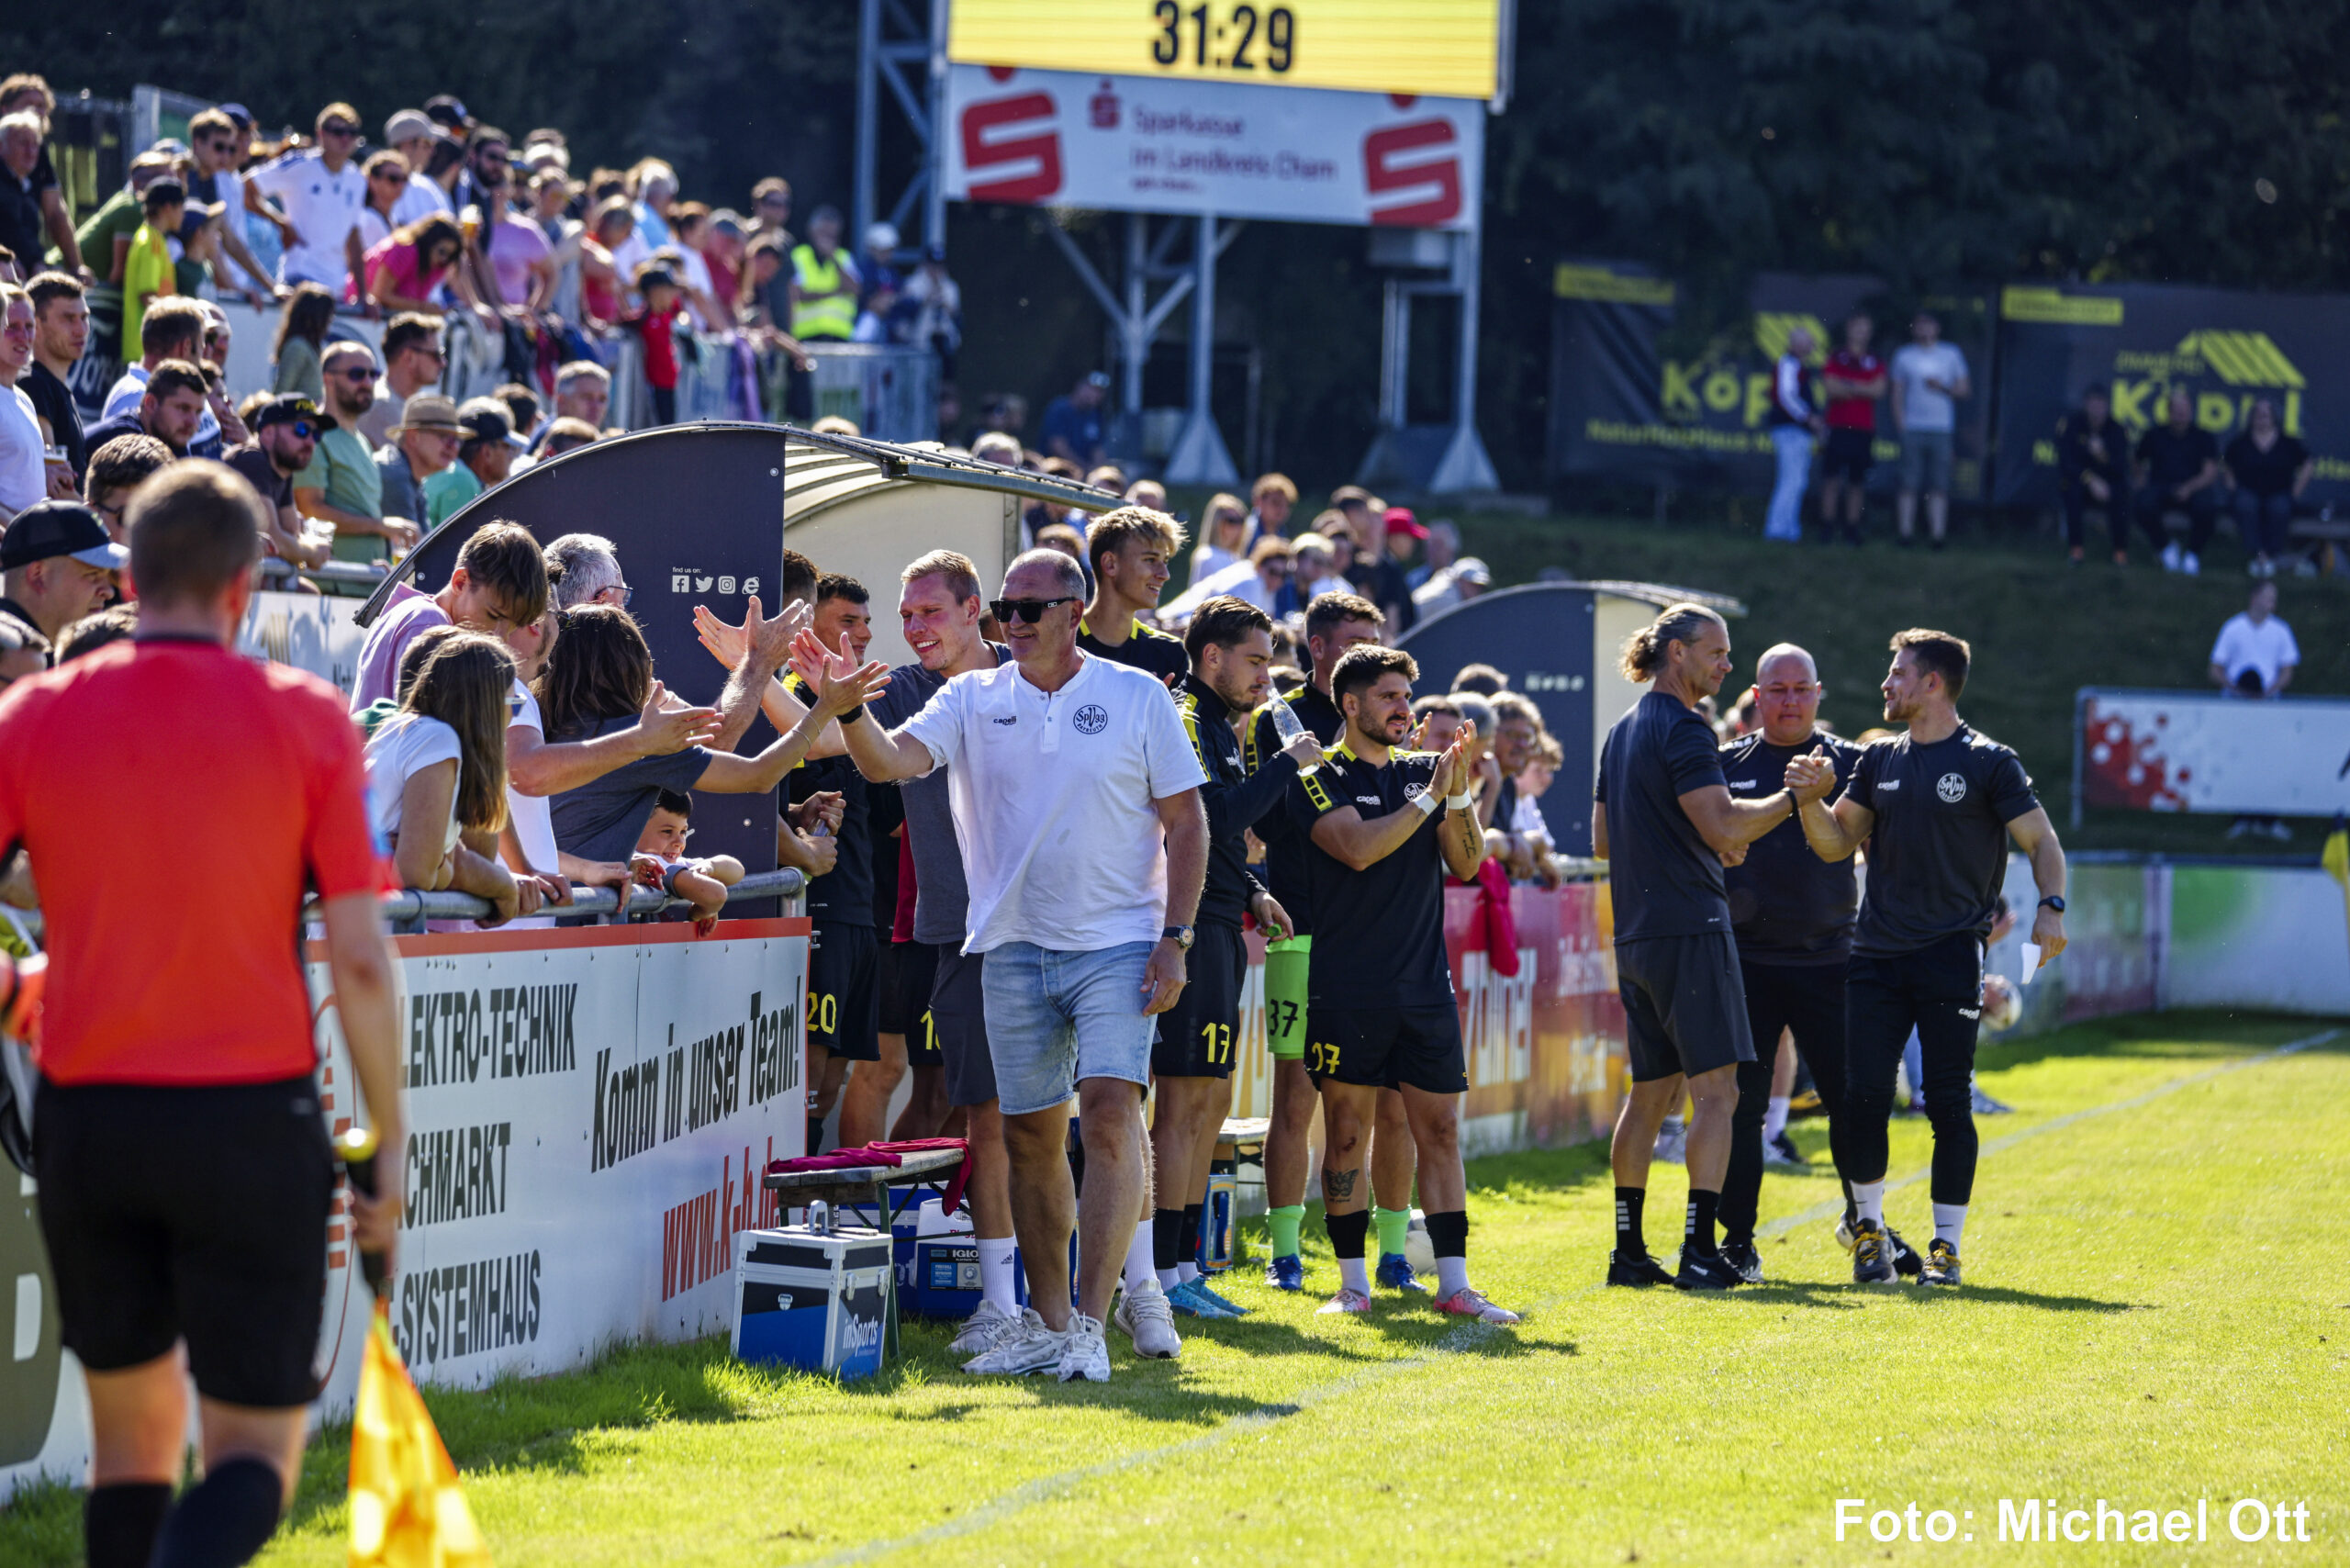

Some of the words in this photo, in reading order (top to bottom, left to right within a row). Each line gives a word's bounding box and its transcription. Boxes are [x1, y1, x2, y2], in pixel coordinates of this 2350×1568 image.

[1154, 0, 1293, 72] 31:29
[1131, 103, 1245, 140] Sparkasse
[1129, 147, 1158, 171] im
[1163, 144, 1270, 180] Landkreis
[1273, 149, 1338, 184] Cham
[807, 991, 837, 1035] 20
[920, 1010, 941, 1050] 1
[1270, 999, 1299, 1038] 37
[398, 983, 578, 1091] LEKTRO-TECHNIK
[1202, 1022, 1230, 1064] 17
[592, 1047, 659, 1174] Komm
[663, 1022, 684, 1143] in
[688, 1021, 745, 1135] unser
[748, 975, 801, 1107] Team!
[397, 1122, 510, 1230] CHMARKT
[952, 1249, 979, 1259] IGLO
[843, 1313, 878, 1358] inSports
